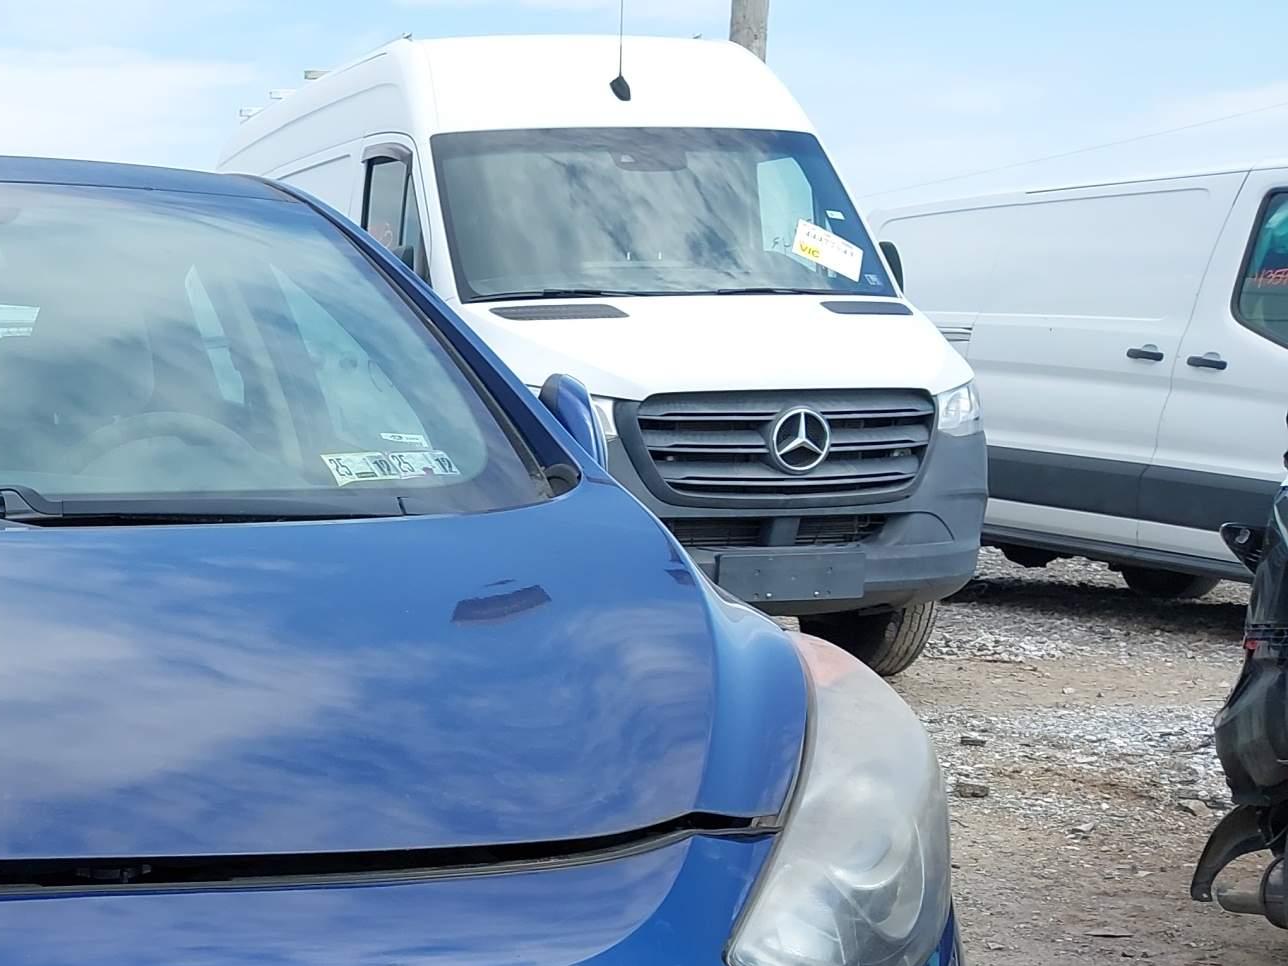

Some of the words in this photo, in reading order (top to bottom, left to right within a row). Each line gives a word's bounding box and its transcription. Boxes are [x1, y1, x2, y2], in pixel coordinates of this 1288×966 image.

[328, 457, 353, 477] 25
[372, 459, 393, 476] 12
[391, 454, 415, 473] 25
[434, 457, 458, 473] 12
